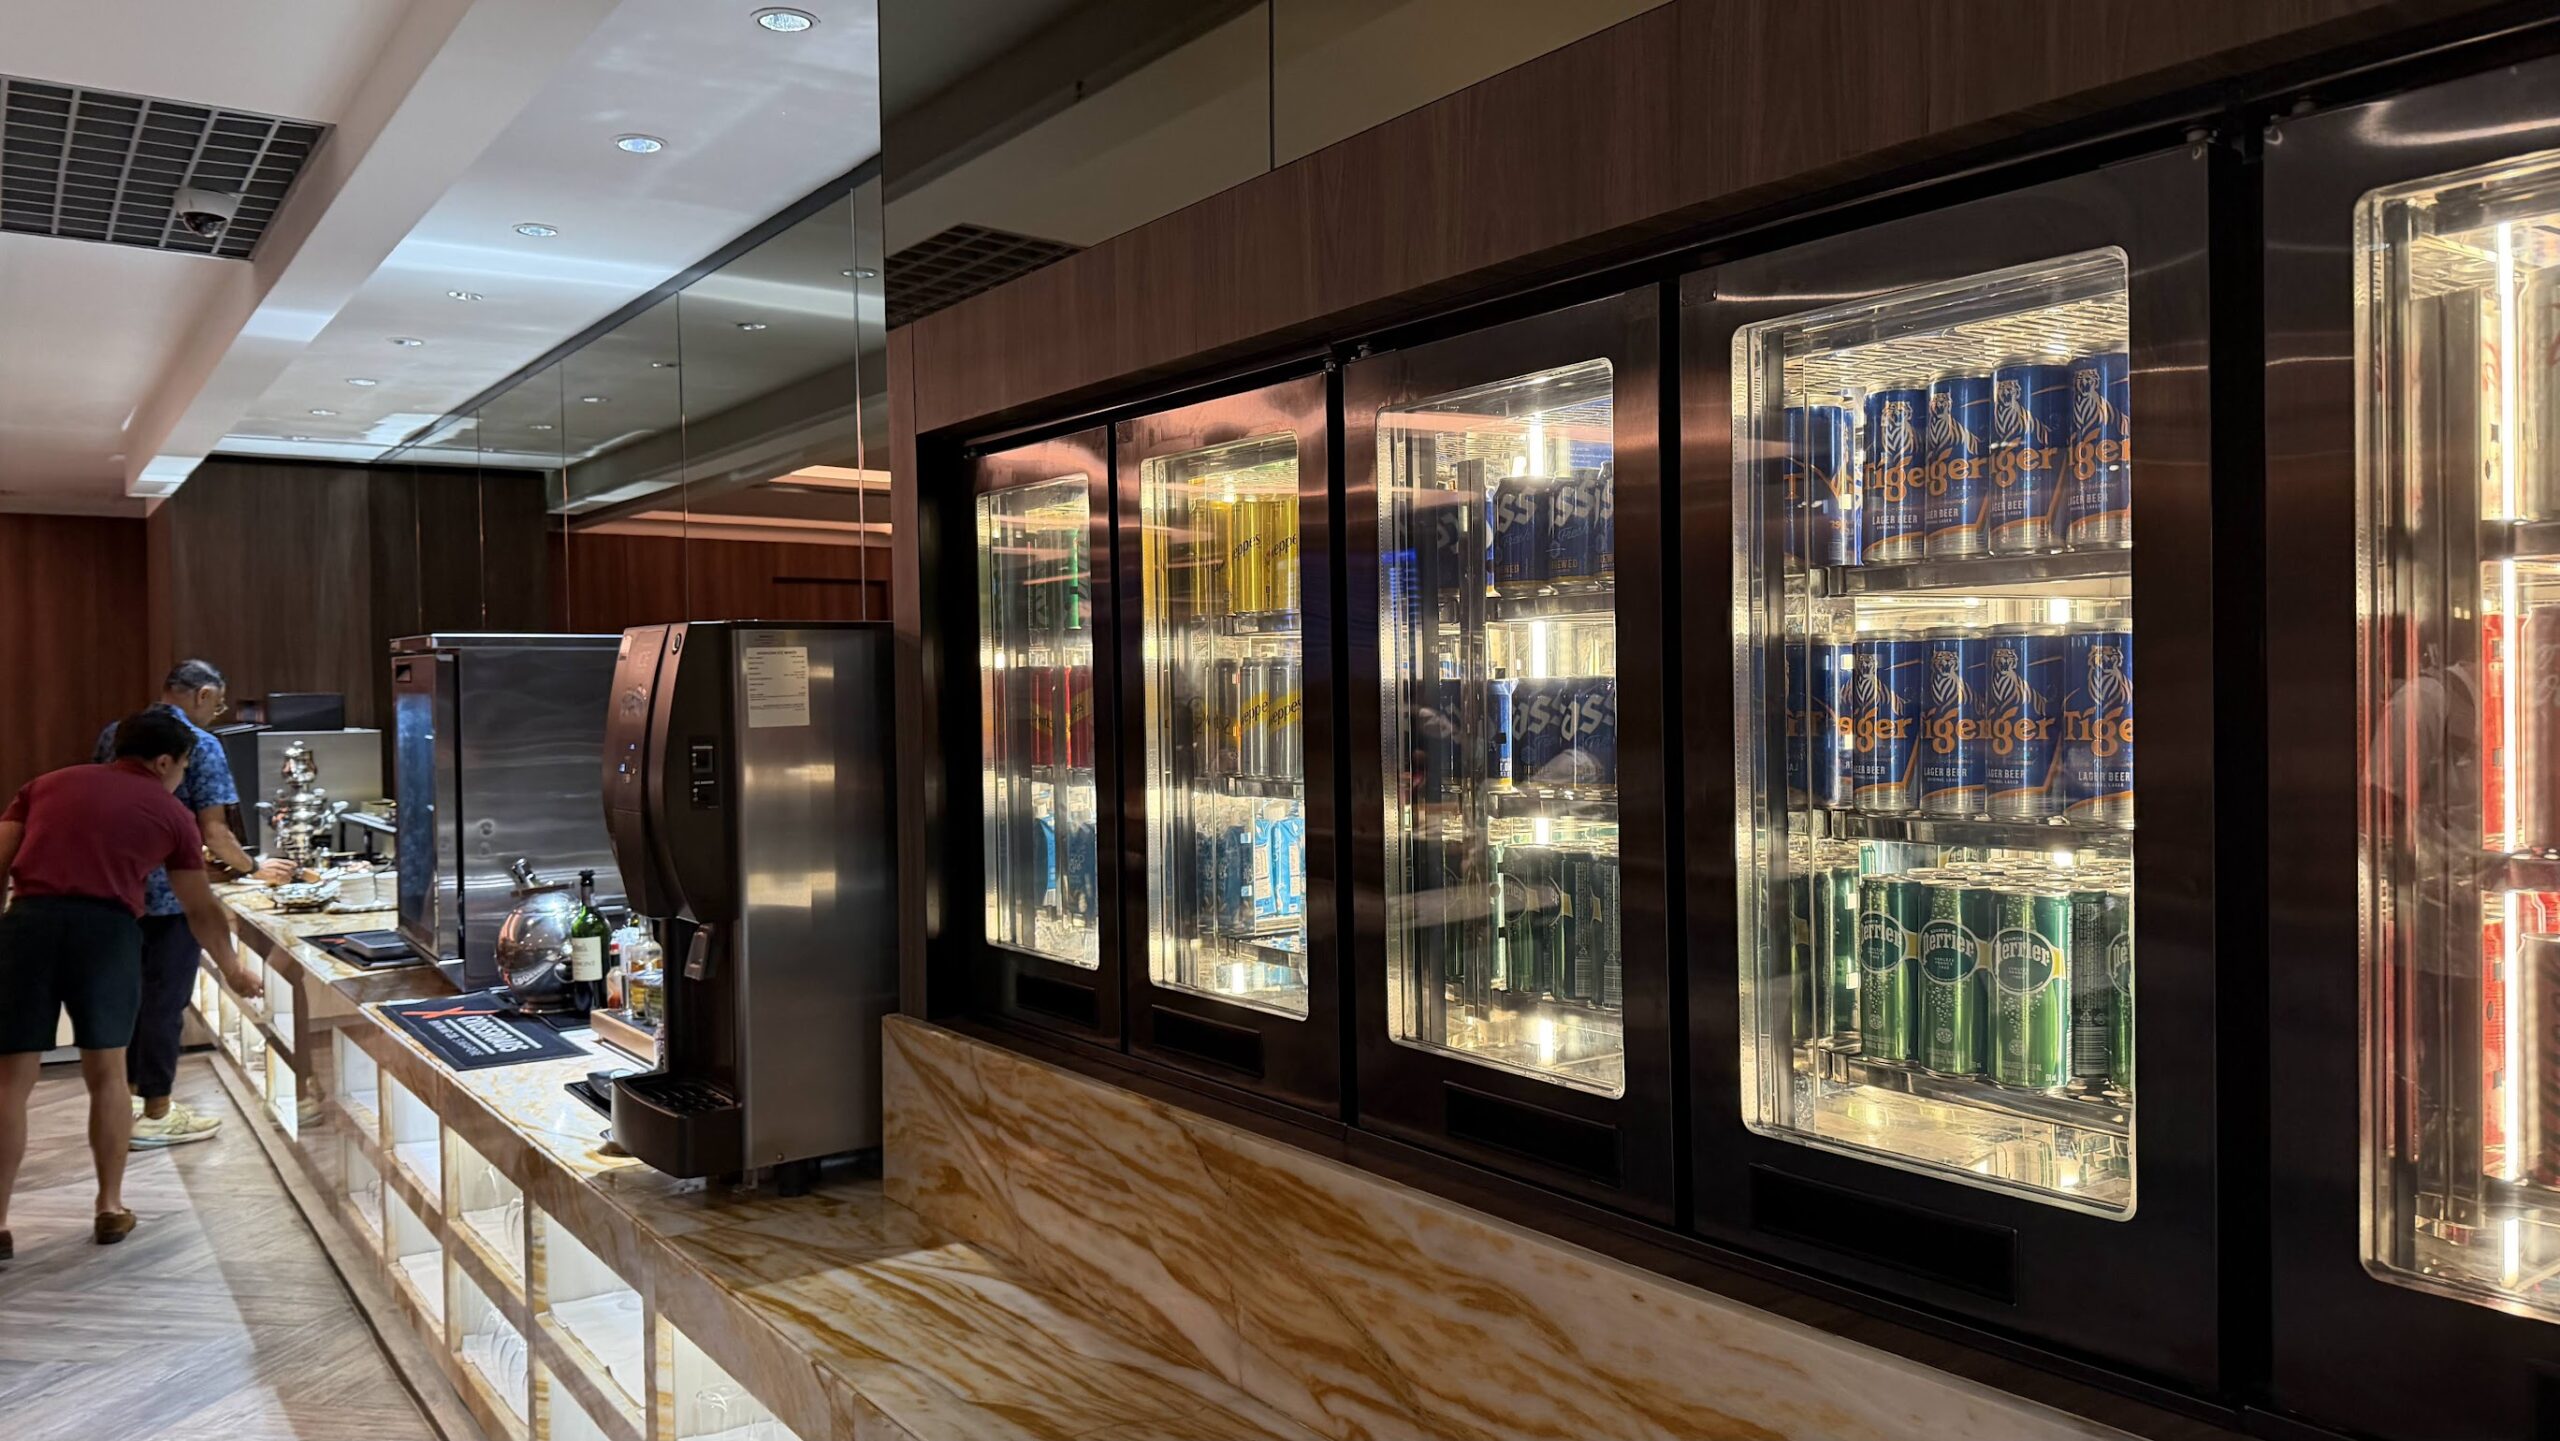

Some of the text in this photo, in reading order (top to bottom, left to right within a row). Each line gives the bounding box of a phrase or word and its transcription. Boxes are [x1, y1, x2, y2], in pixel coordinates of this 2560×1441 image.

[1923, 707, 1987, 755] ige
[1866, 766, 1886, 775] BEER
[2078, 771, 2131, 781] LAGER BEER
